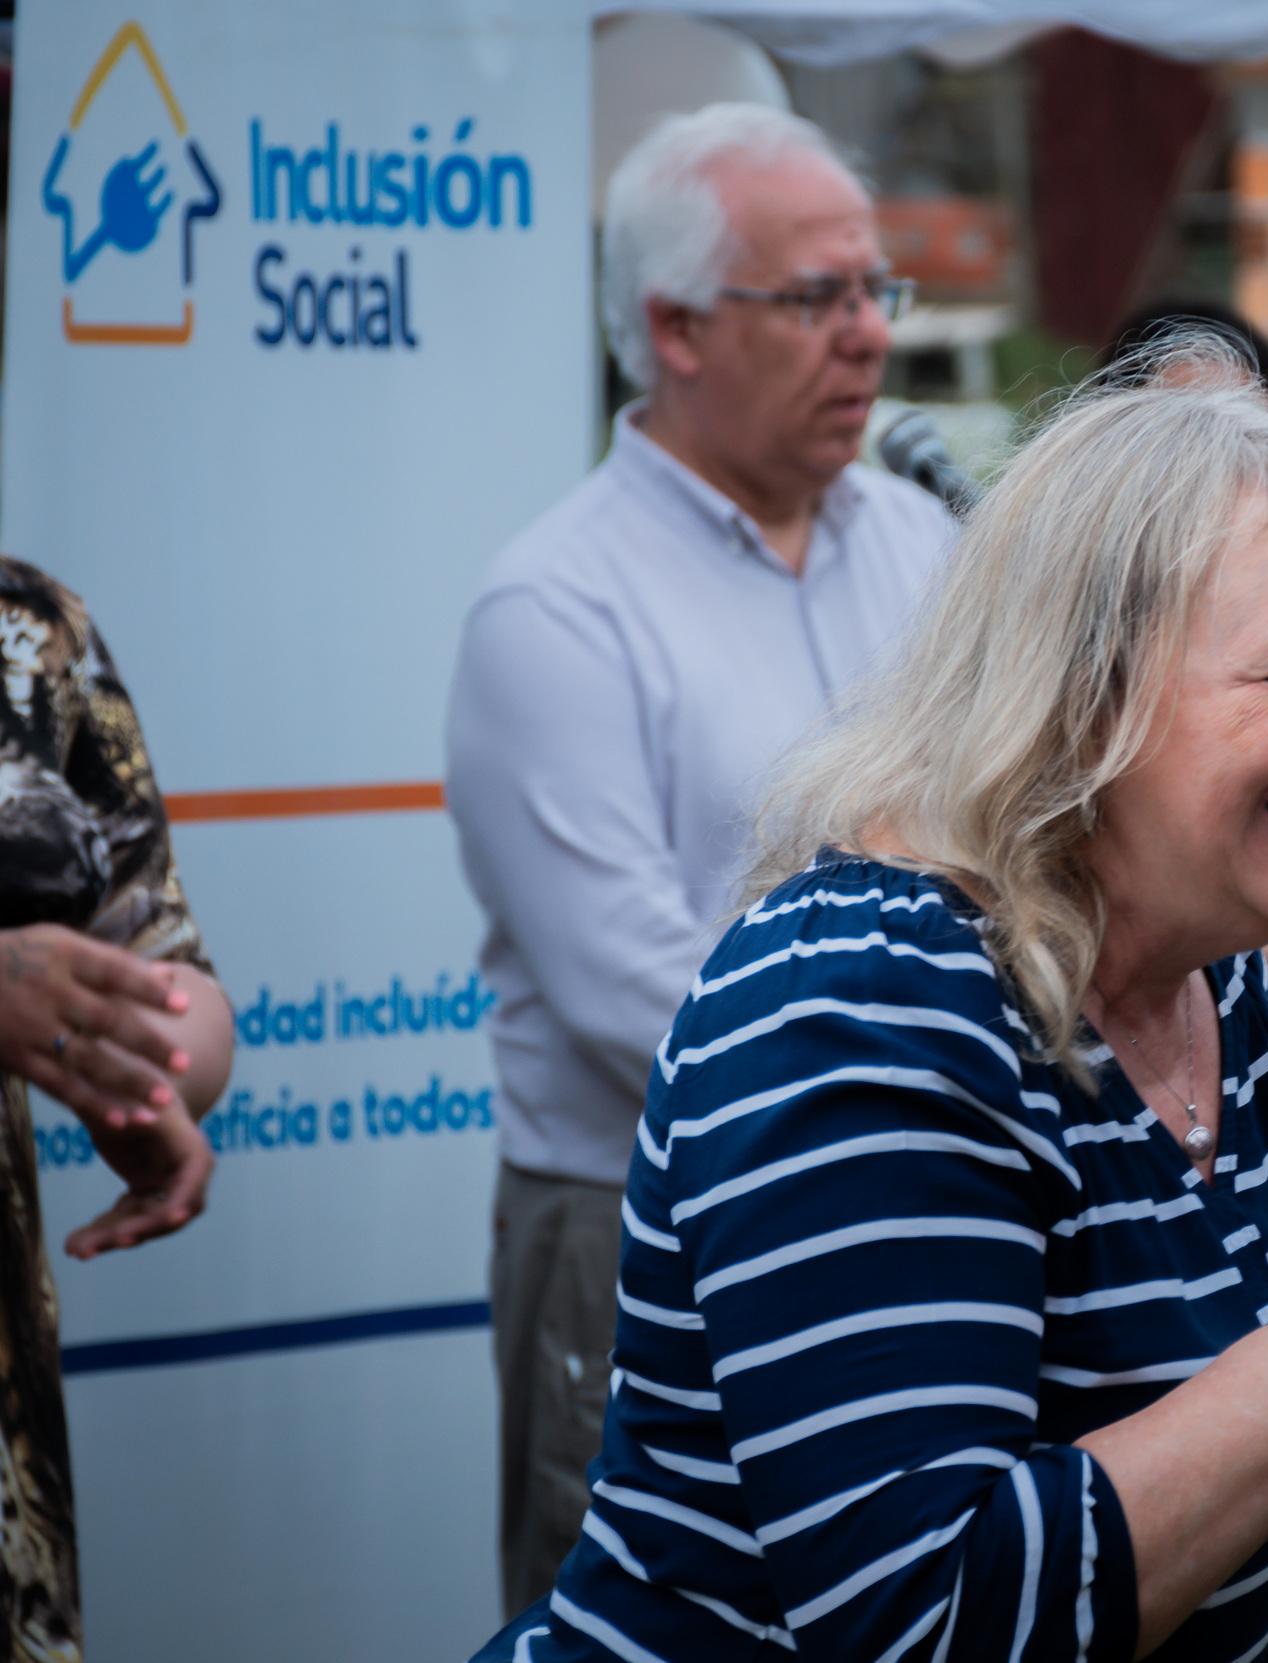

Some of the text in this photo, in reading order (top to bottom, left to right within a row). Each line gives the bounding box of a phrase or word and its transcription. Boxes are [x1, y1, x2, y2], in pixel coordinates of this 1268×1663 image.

[250, 116, 532, 229] Inclusión
[256, 245, 419, 349] Social
[237, 983, 325, 1046] dad
[330, 1099, 350, 1140] a
[363, 1072, 494, 1139] todos
